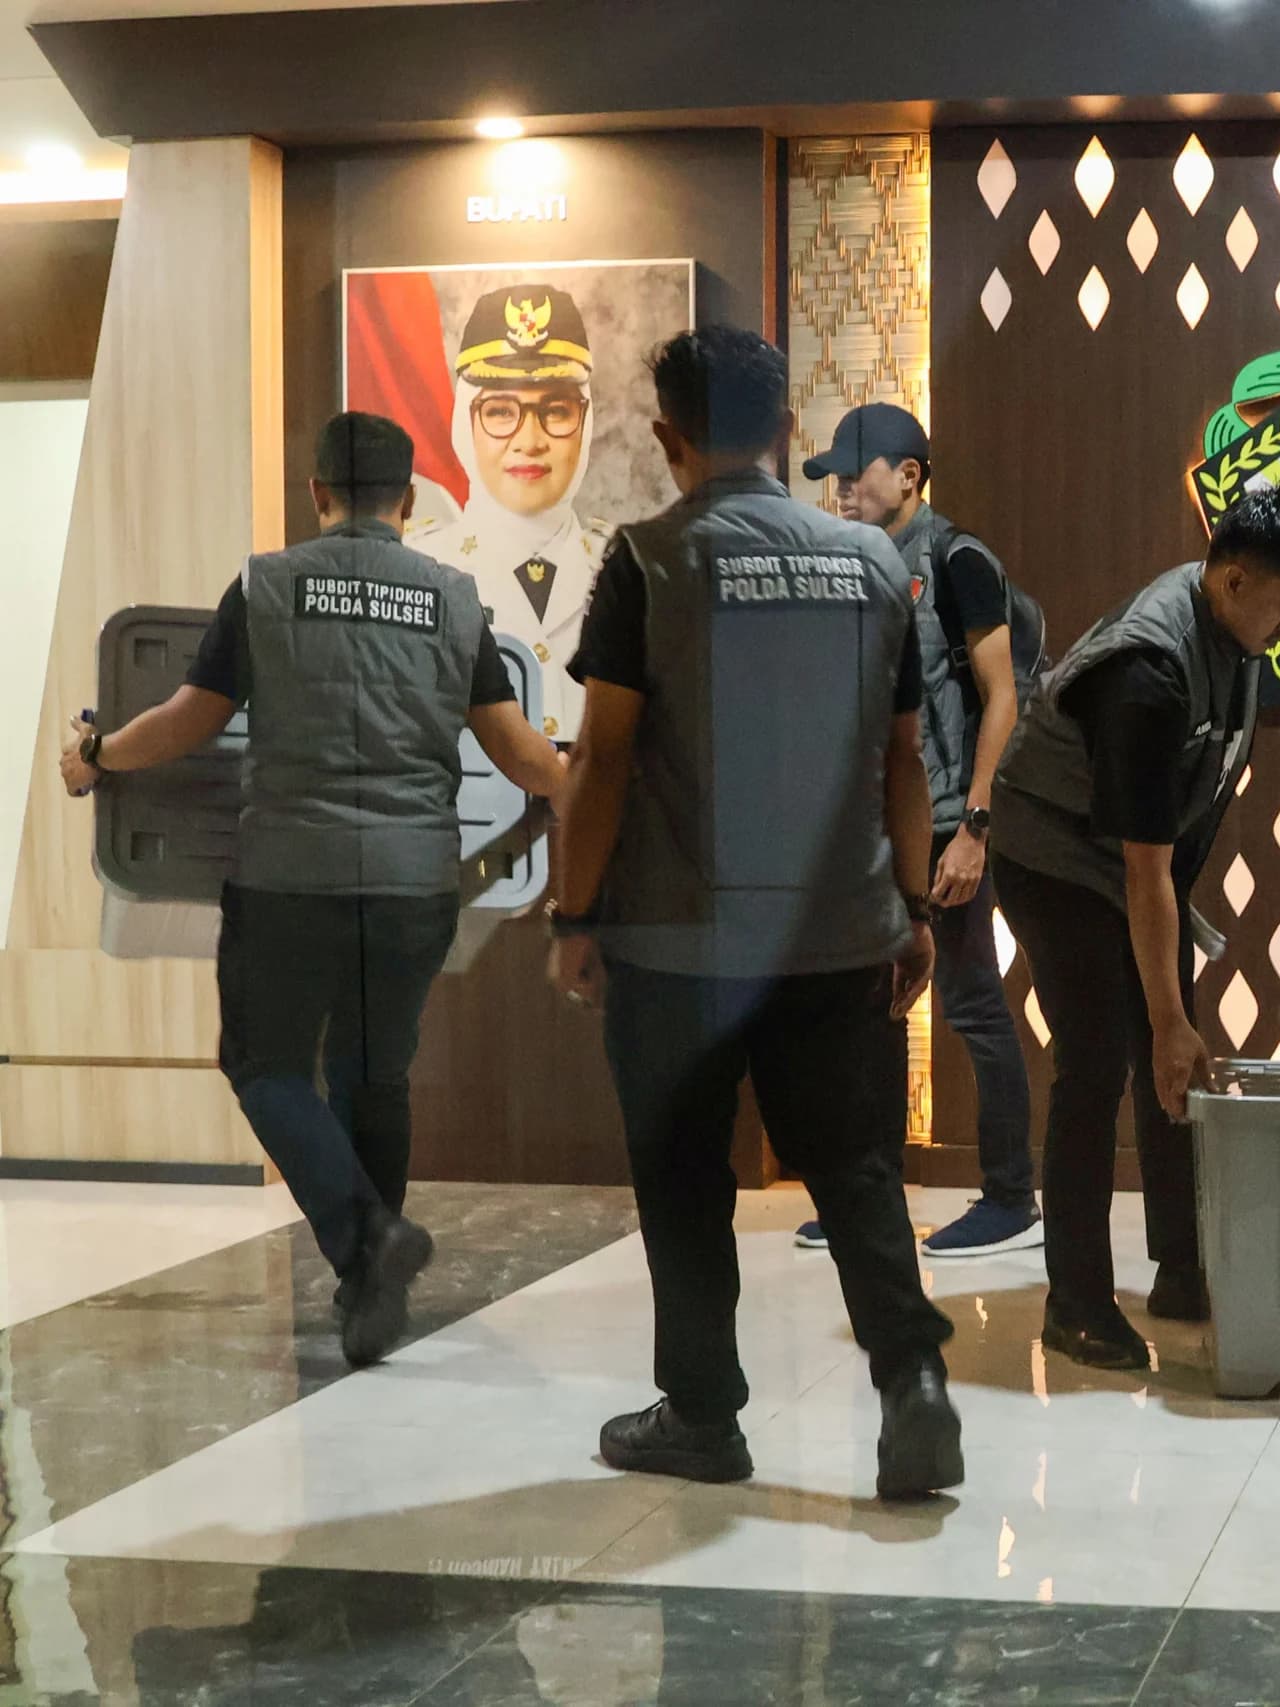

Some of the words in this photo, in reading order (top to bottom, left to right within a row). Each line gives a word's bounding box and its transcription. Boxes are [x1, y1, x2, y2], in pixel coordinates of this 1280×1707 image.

[466, 194, 567, 223] BUPATI
[716, 555, 782, 577] SUBDIT
[784, 554, 865, 577] TIPIDKOR
[305, 577, 362, 595] SUBDIT
[365, 582, 434, 608] TIPIDKOR
[719, 575, 791, 602] POLDA
[793, 575, 870, 601] SULSEL
[304, 594, 364, 616] POLDA
[368, 599, 434, 627] SULSEL
